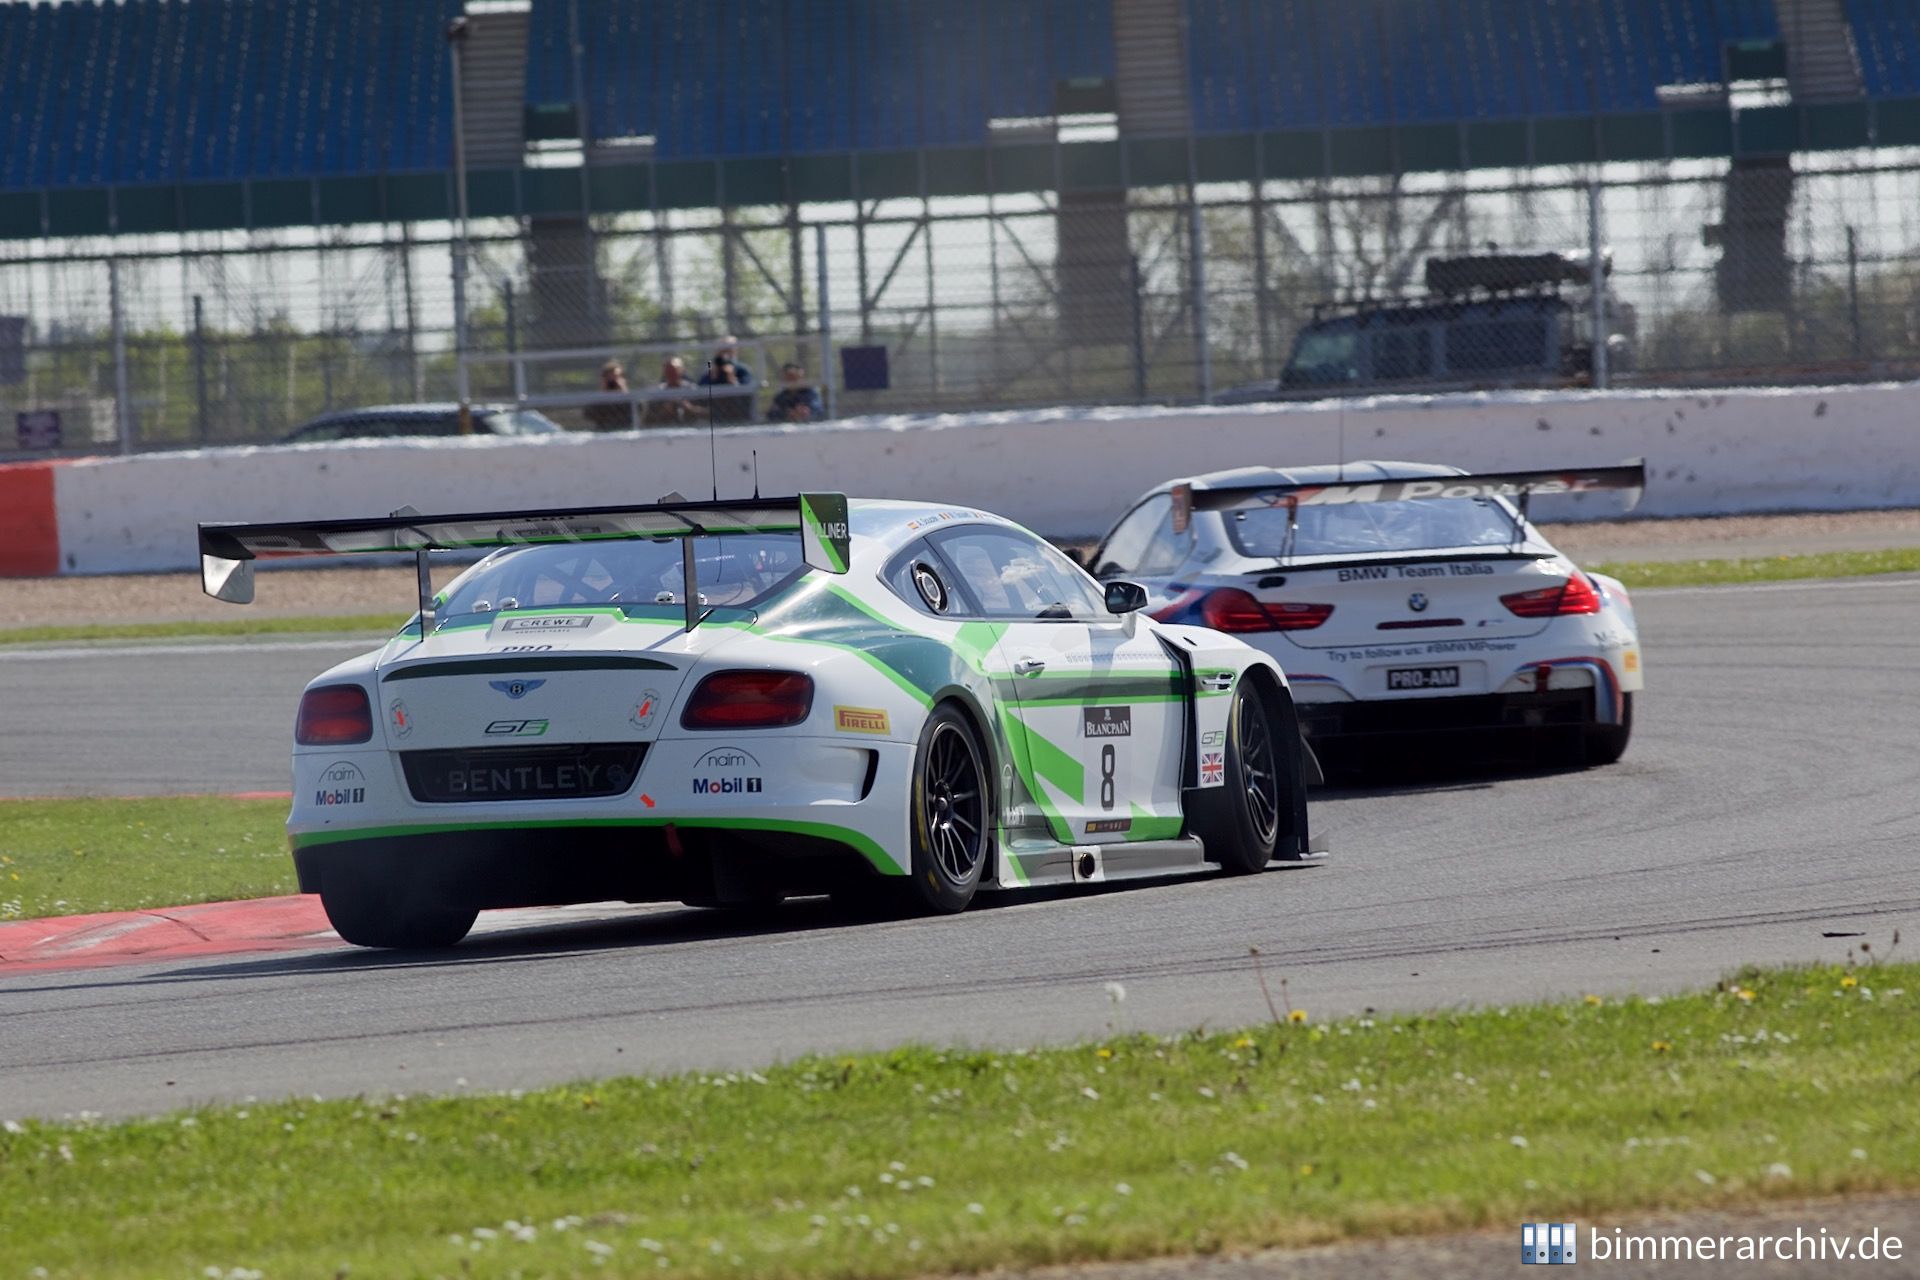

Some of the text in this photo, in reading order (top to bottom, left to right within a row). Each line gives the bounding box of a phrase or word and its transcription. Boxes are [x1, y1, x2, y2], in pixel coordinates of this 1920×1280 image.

[1338, 562, 1494, 582] BMW Team Italia
[1327, 651, 1347, 662] Try
[1350, 651, 1363, 660] to
[1365, 648, 1402, 660] follow
[1390, 670, 1457, 688] PRO-AM
[839, 710, 885, 730] PIRELLI
[1086, 720, 1129, 735] BLANCPAIN
[708, 754, 745, 767] naim
[328, 769, 355, 781] naim
[450, 765, 600, 792] BENTLEY
[1101, 744, 1115, 812] 8
[693, 778, 762, 794] Mobil 1
[315, 788, 364, 805] Mobil 1
